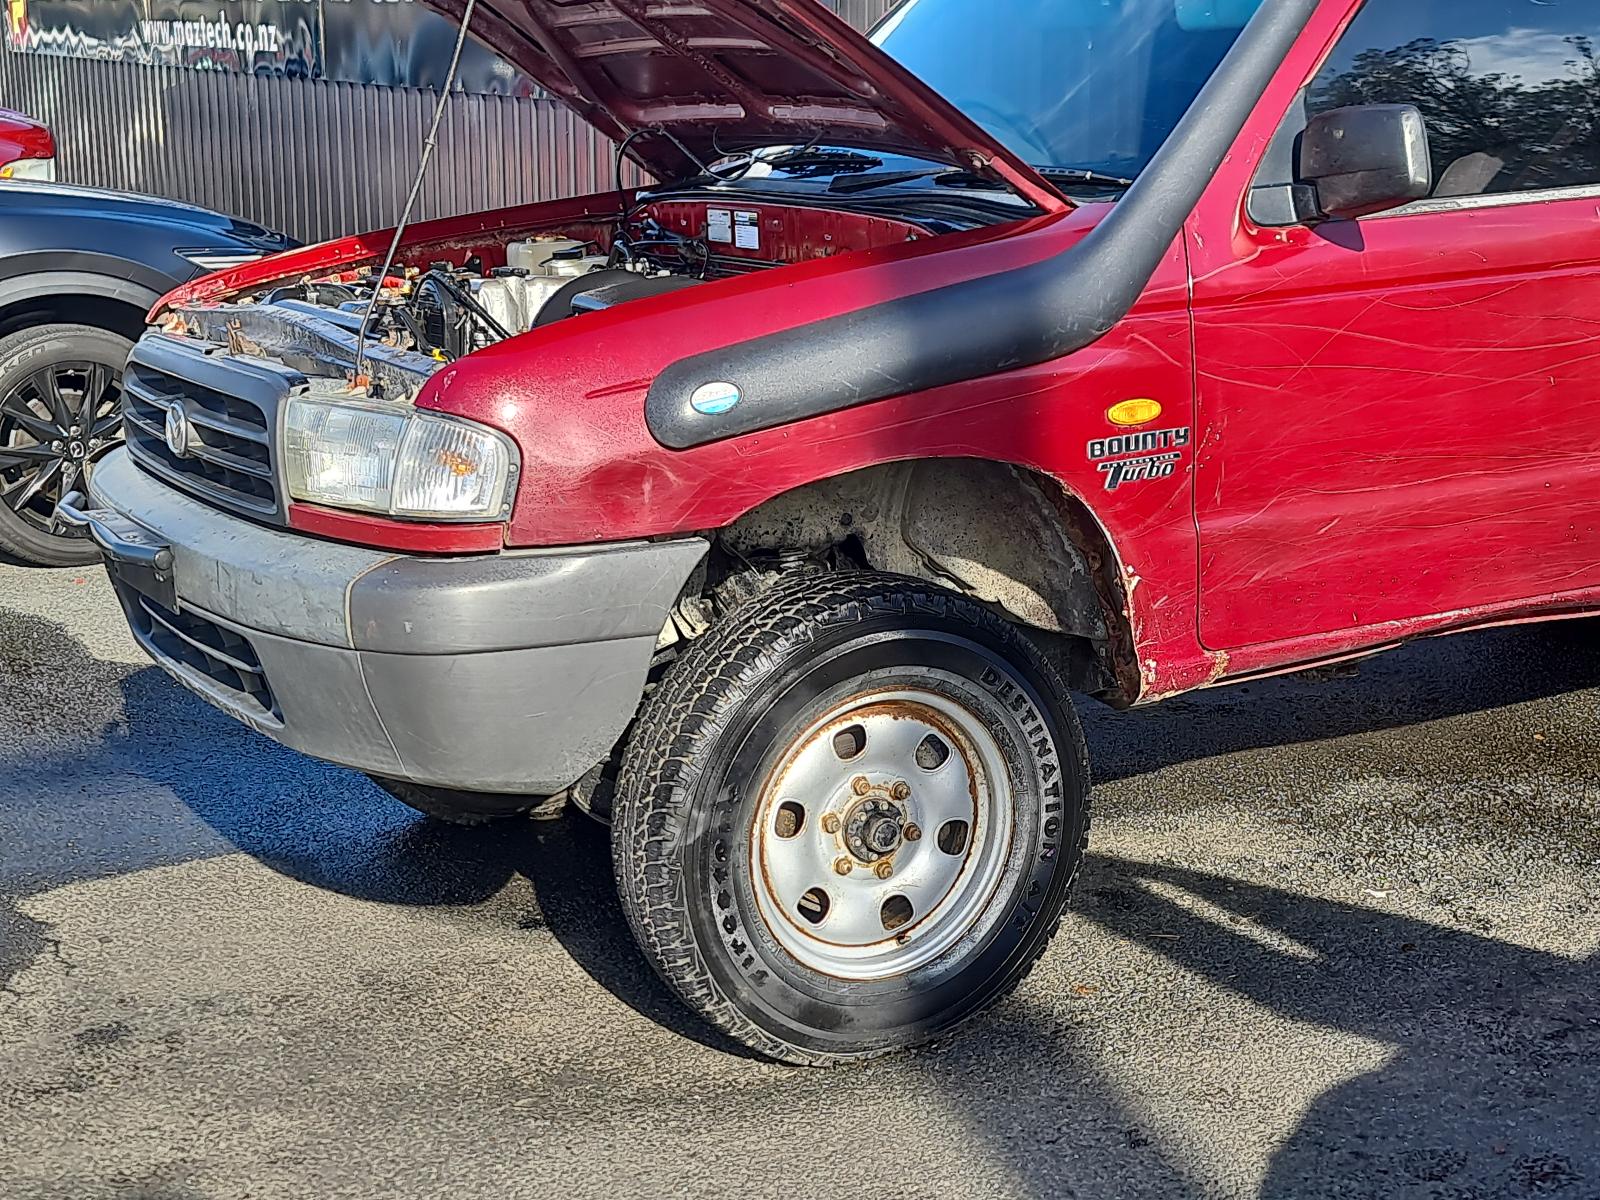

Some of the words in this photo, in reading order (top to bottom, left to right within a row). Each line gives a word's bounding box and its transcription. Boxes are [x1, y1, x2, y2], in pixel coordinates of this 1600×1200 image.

[141, 10, 278, 51] www.maztech.co.nz
[1087, 427, 1190, 459] BOUNTY
[1097, 452, 1182, 490] Turbo
[980, 666, 1060, 862] DESTINATION
